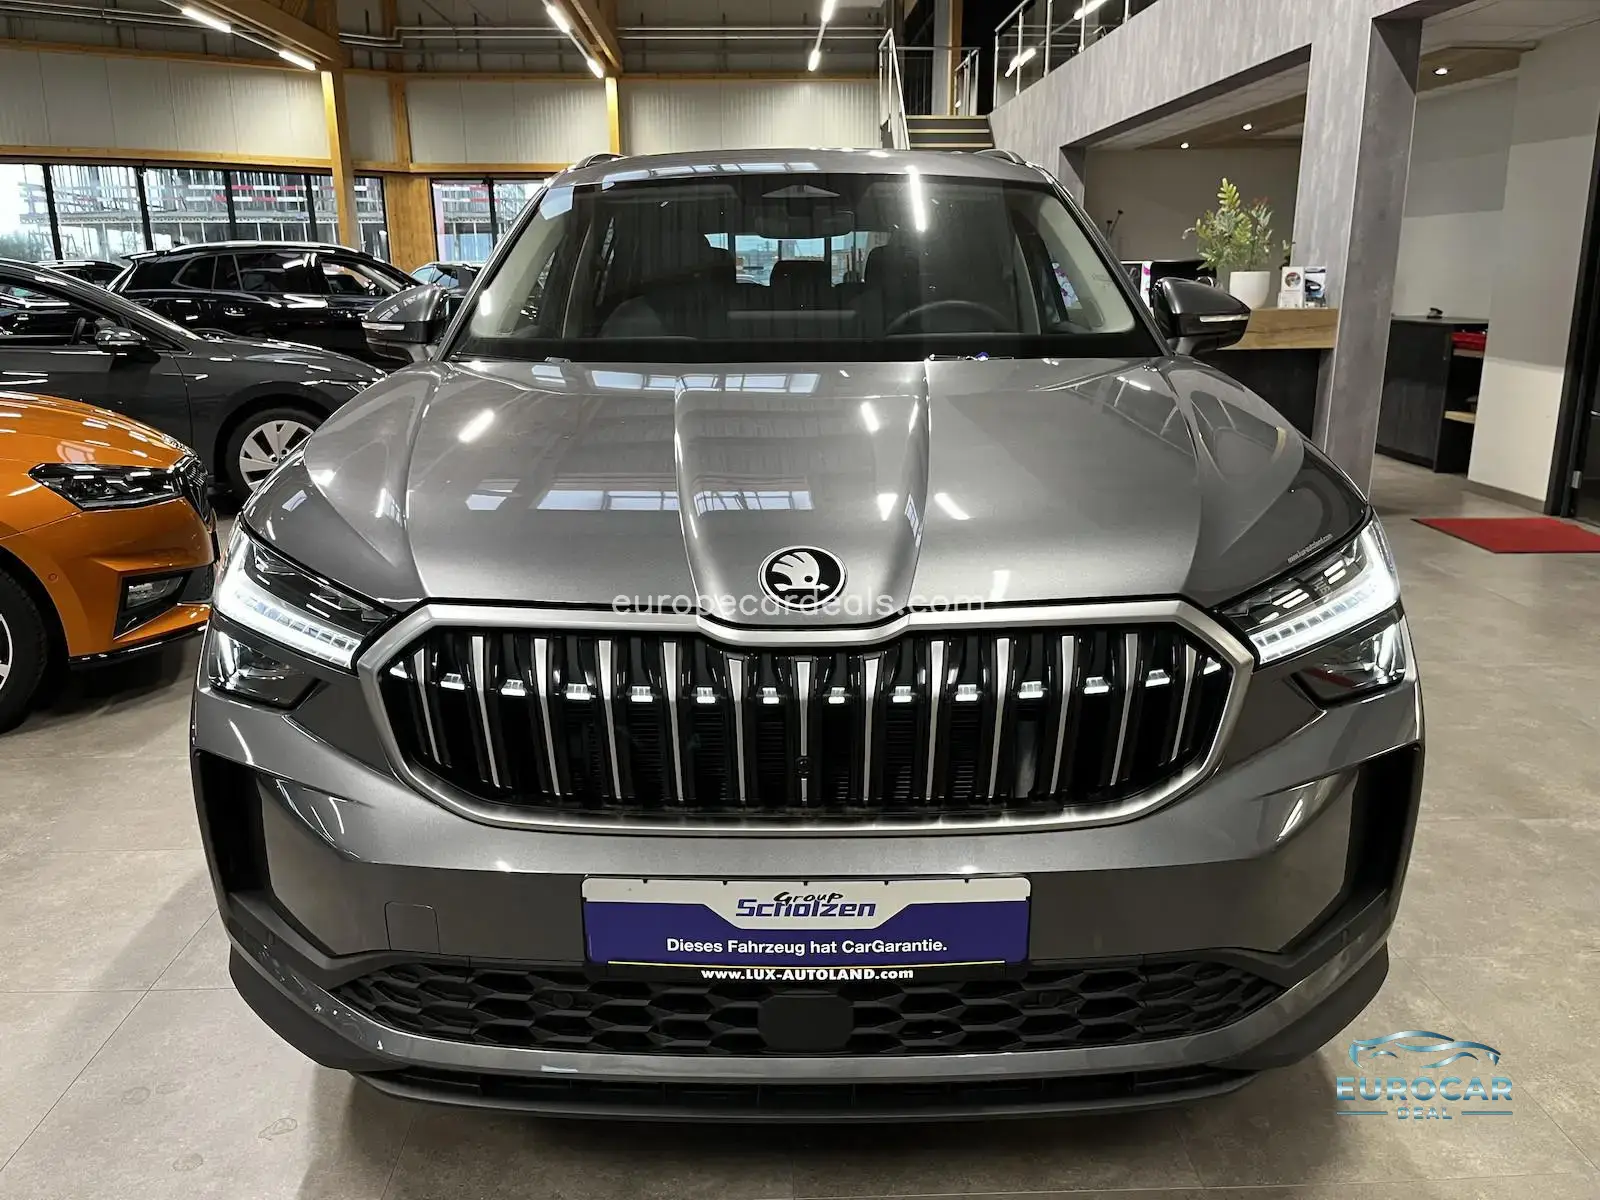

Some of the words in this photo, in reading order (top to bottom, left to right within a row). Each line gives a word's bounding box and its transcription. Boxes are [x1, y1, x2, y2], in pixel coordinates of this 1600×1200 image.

[774, 891, 843, 904] Group
[735, 898, 876, 918] Scholzen
[666, 938, 723, 953] Dieses
[727, 939, 805, 957] Fahrzeug
[810, 939, 837, 954] hat
[842, 938, 947, 954] CarGarantie.
[701, 967, 914, 981] www.LUX-AUTOLAND.com
